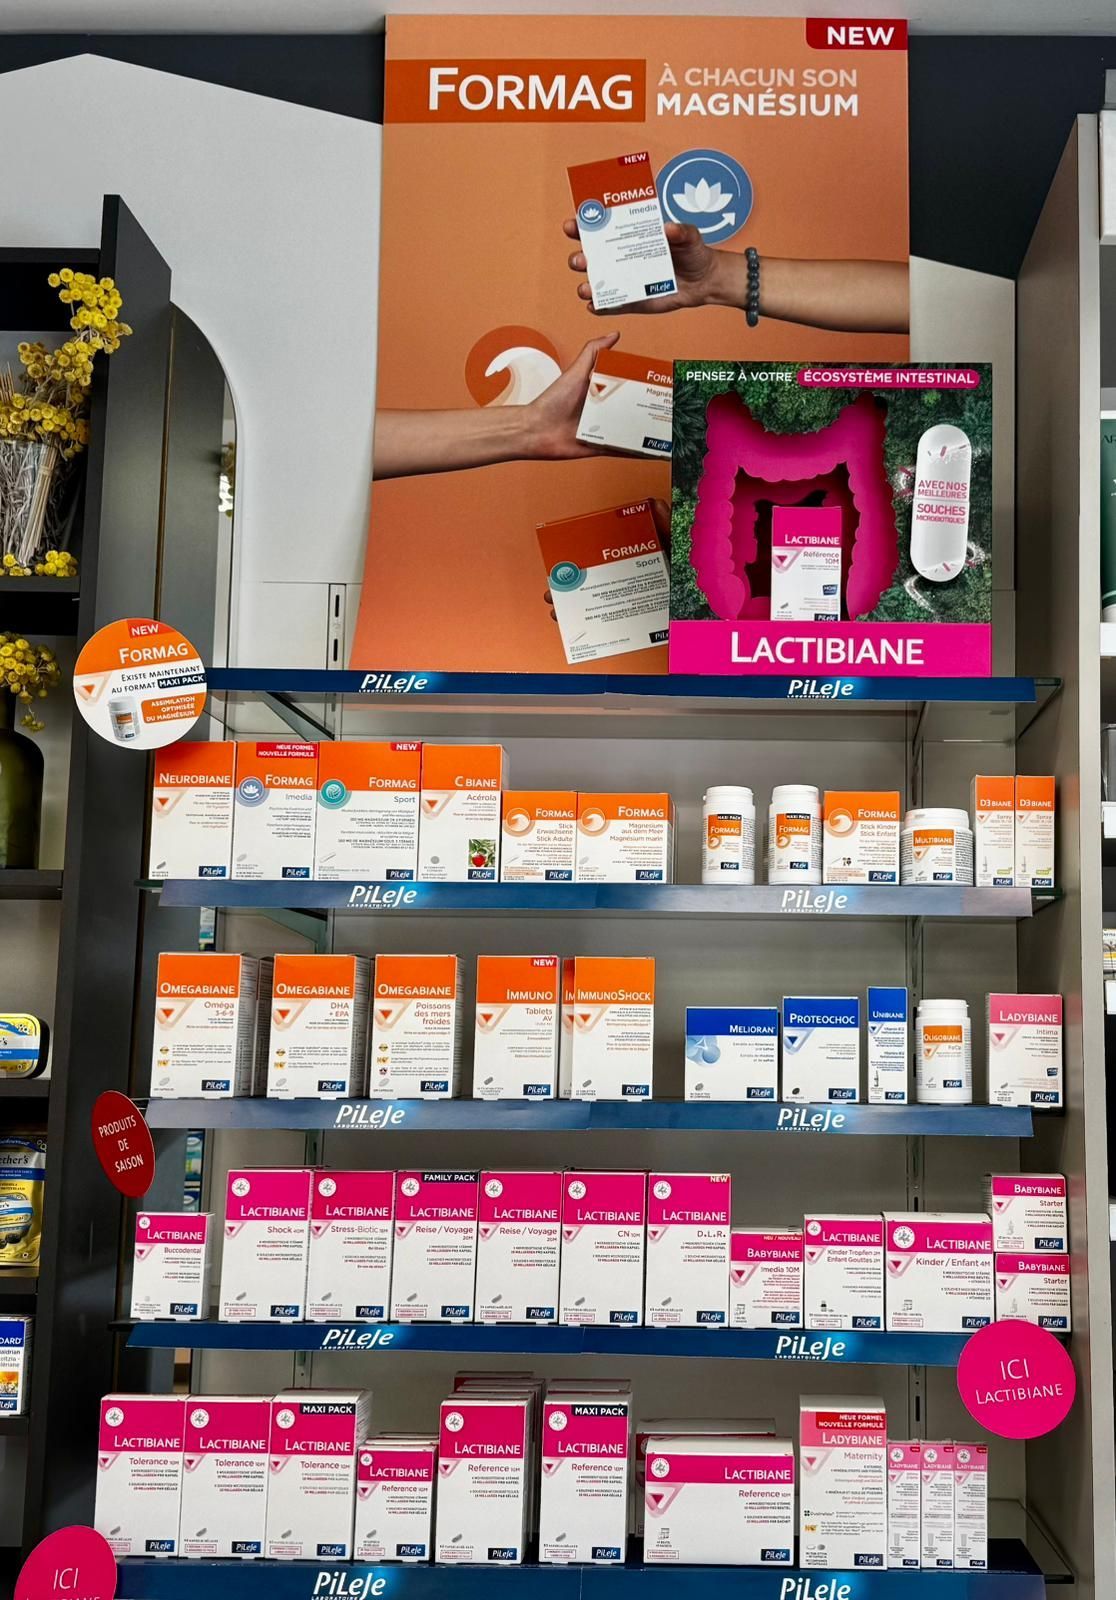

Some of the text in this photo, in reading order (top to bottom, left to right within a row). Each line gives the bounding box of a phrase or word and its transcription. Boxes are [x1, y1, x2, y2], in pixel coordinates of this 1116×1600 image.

[827, 26, 895, 46] NEW
[658, 64, 857, 87] À CHACUN SON
[428, 67, 633, 110] FORMAG
[656, 87, 859, 117] MAGNÉSIUM
[624, 153, 646, 164] NEW
[603, 186, 654, 205] FORMAG
[686, 369, 975, 385] PENSEZ À VOTRE ÉCOSYSTÈME INTESTINAL
[918, 480, 967, 491] AVEC NOS
[918, 489, 967, 499] MEILLEURES
[622, 504, 646, 516] NEW
[917, 503, 966, 516] SOUCHES
[785, 534, 840, 545] LACTIBIANE
[602, 540, 657, 561] FORMAG
[636, 557, 660, 569] Sport
[131, 624, 159, 636] NEW
[119, 643, 189, 664] FORMAG
[731, 631, 925, 666] LACTIBIANE
[121, 665, 201, 682] EXISTE MAINTENANT
[124, 681, 156, 693] FORMAT
[159, 679, 180, 688] MAXI
[182, 675, 204, 684] PACK
[361, 674, 428, 692] PiLeJe
[788, 679, 854, 698] PiLeJe
[160, 773, 231, 784] NEUROBIANE
[265, 774, 313, 786] FORMAG
[369, 777, 416, 788] FORMAG
[454, 776, 497, 787] C BIANE
[394, 796, 415, 804] Sport
[467, 793, 497, 801] Acérola
[980, 799, 991, 807] D3
[1020, 799, 1031, 807] D3
[536, 808, 574, 818] FORMAG
[618, 806, 664, 817] FORMAG
[858, 809, 897, 819] FORMAG
[711, 826, 740, 834] FORMAG
[349, 885, 417, 907] PiLeJe
[781, 890, 848, 913] PiLeJe
[160, 982, 235, 994] OMEGABIANE
[276, 983, 350, 995] OMEGABIANE
[378, 983, 452, 996] OMEGABIANE
[506, 988, 553, 1000] IMMUNO
[204, 1001, 234, 1010] Oméga
[416, 1002, 451, 1010] Poissons
[790, 1013, 855, 1025] PROTEOCHOC
[1000, 1010, 1058, 1022] LADYBIANE
[729, 1024, 773, 1033] MELIORAN
[335, 1104, 405, 1128] PiLeJe
[777, 1108, 845, 1132] PiLeJe
[99, 1114, 137, 1138] PRODUITS
[117, 1138, 129, 1151] DE
[115, 1154, 144, 1173] SAISON
[1014, 1184, 1062, 1194] BABYBIANE
[240, 1205, 305, 1217] LACTIBIANE
[326, 1205, 389, 1217] LACTIBIANE
[410, 1206, 475, 1218] LACTIBIANE
[494, 1207, 558, 1219] LACTIBIANE
[577, 1209, 641, 1221] LACTIBIANE
[662, 1209, 727, 1221] LACTIBIANE
[147, 1229, 203, 1240] LACTIBIANE
[267, 1226, 292, 1234] Shock
[331, 1225, 378, 1233] Stress-Biotic
[444, 1226, 473, 1236] Voyage
[528, 1228, 557, 1237] Voyage
[823, 1231, 880, 1243] LACTIBIANE
[926, 1237, 991, 1250] LACTIBIANE
[747, 1248, 800, 1259] BABYBIANE
[916, 1257, 944, 1267] Kinder
[951, 1258, 979, 1267] Enfant
[1018, 1261, 1066, 1272] BABYBIANE
[322, 1329, 394, 1348] PiLeJe
[776, 1335, 845, 1360] PiLeJe
[1000, 1359, 1030, 1380] ICI
[975, 1383, 1063, 1405] LACTIBIANE
[328, 1406, 352, 1414] PACK
[575, 1407, 624, 1416] MAXI PACK
[114, 1435, 181, 1448] LACTIBIANE
[200, 1437, 266, 1449] LACTIBIANE
[822, 1432, 882, 1445] LADYBIANE
[285, 1439, 350, 1452] LACTIBIANE
[454, 1442, 520, 1454] LACTIBIANE
[558, 1441, 623, 1454] LACTIBIANE
[129, 1457, 168, 1465] Tolerance
[214, 1459, 254, 1467] Tolerance
[844, 1452, 883, 1462] Maternity
[300, 1461, 339, 1469] Tolerance
[571, 1464, 612, 1472] Reference
[370, 1466, 428, 1478] LACTIBIANE
[725, 1467, 791, 1480] LACTIBIANE
[739, 1490, 780, 1498] Reference
[53, 1568, 79, 1591] ICI
[313, 1571, 385, 1600] PiLeJe
